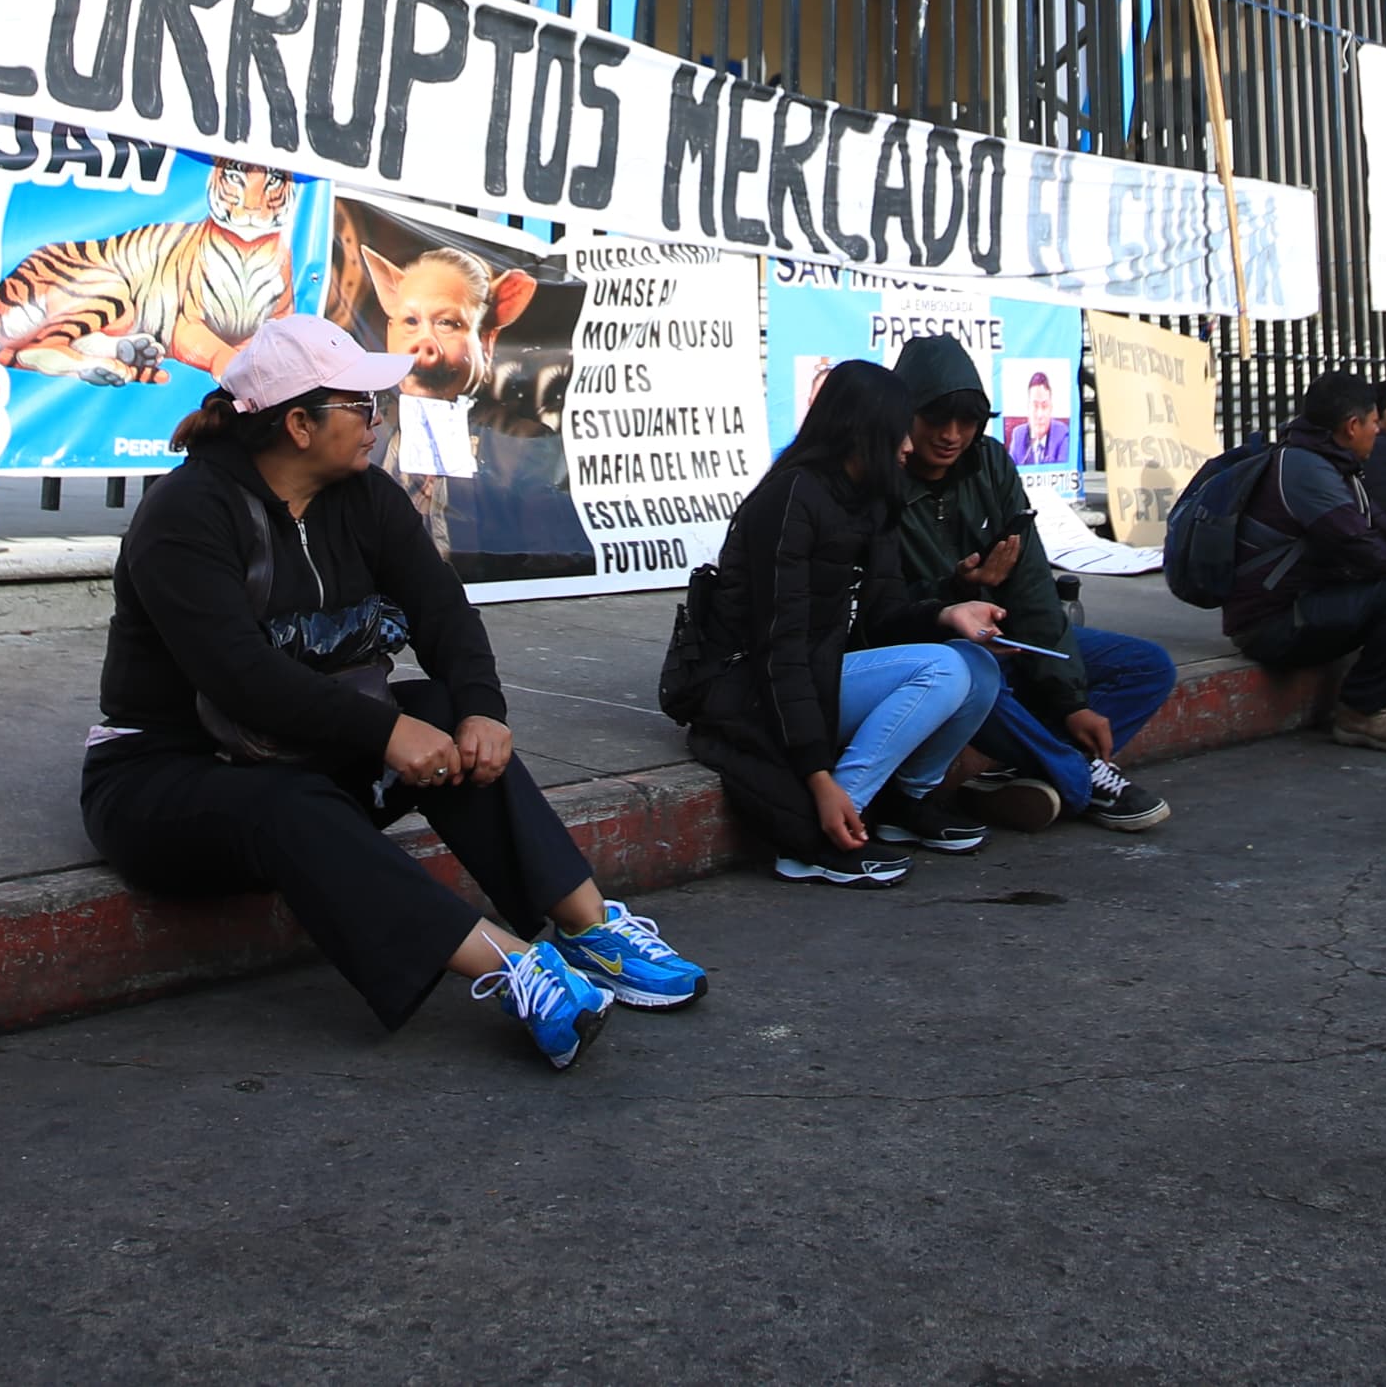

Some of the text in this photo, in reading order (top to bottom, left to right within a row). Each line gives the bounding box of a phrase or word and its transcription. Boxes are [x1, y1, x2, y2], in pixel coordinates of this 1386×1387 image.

[662, 63, 1005, 275] MERCADO
[1027, 151, 1086, 296] EL
[575, 246, 660, 274] PUEBLO
[710, 320, 733, 348] SU
[574, 364, 652, 394] HIJO ES
[571, 406, 745, 440] ESTUDIANTE Y LA
[577, 449, 749, 486] MAFIA DEL MP LE
[583, 491, 745, 530] ESTÁ ROBANDO
[1116, 486, 1183, 522] PRE
[600, 537, 689, 574] FUTURO
